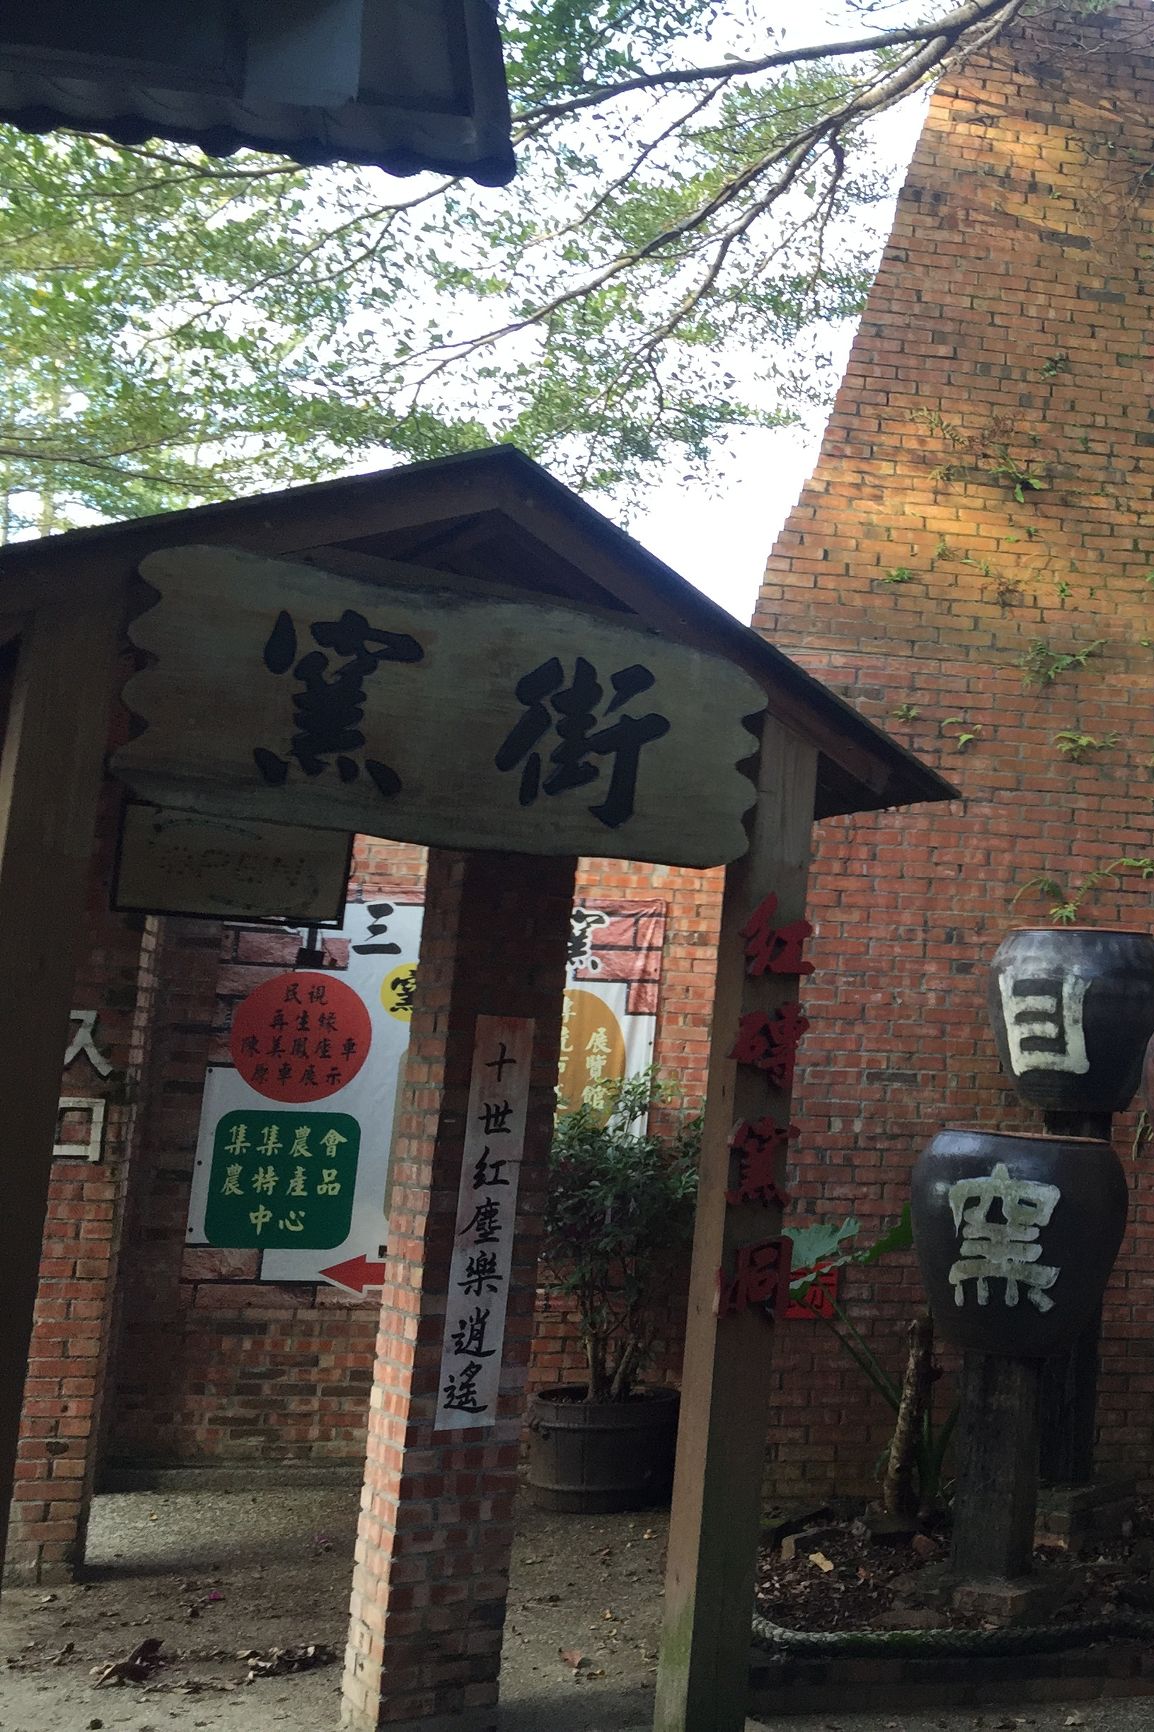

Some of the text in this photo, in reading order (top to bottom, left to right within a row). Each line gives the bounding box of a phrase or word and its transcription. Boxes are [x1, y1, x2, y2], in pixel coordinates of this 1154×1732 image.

[252, 608, 672, 829] 窯街
[352, 902, 402, 956] 三
[283, 982, 329, 1006] 民視
[52, 1009, 114, 1162] 入口
[250, 1062, 342, 1087] 原車展示
[580, 1028, 614, 1112] 展覽館
[718, 892, 815, 1322] 紅磚窯洞
[223, 1125, 349, 1159] 集集農會
[220, 1162, 343, 1200] 農特產品
[248, 1203, 307, 1237] 中心
[443, 1042, 518, 1414] 十世紅塵樂逍遙
[948, 1162, 1062, 1313] 窯
